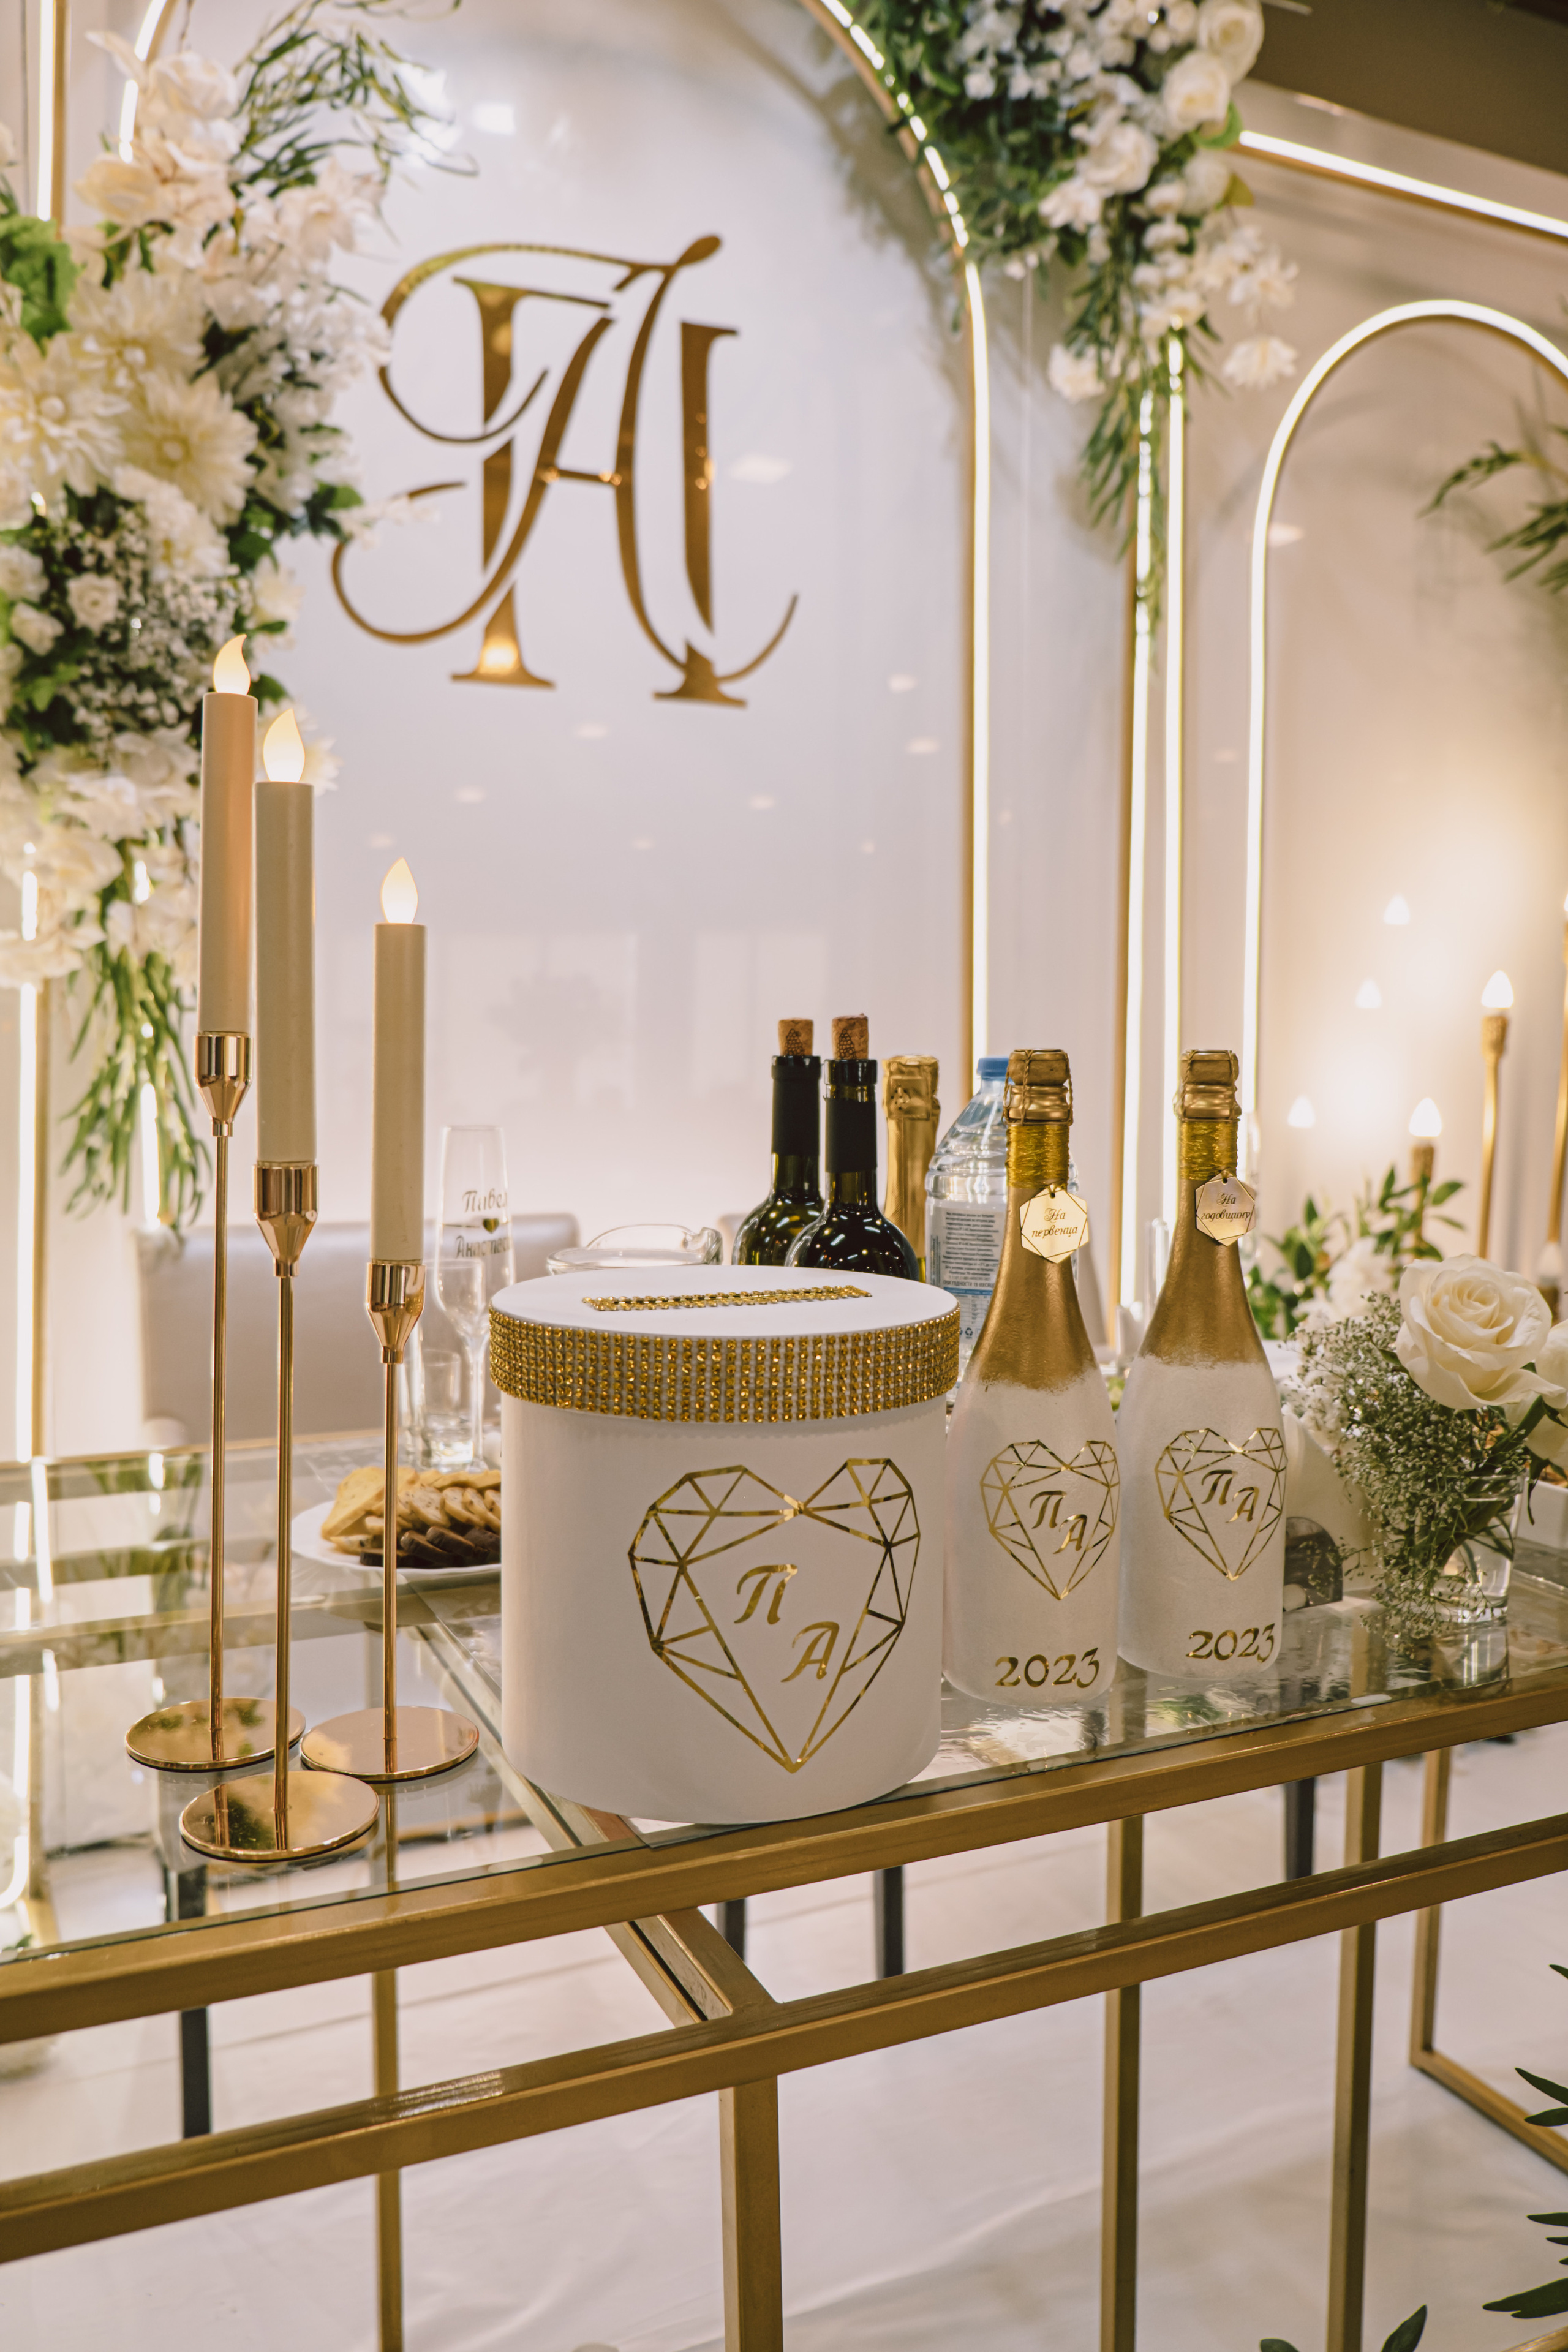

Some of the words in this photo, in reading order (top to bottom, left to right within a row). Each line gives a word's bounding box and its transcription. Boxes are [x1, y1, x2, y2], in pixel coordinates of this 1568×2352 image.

[1044, 1208, 1066, 1223] На
[1200, 1209, 1251, 1222] годовщину
[1216, 1192, 1236, 1207] На
[1031, 1225, 1078, 1238] первенца
[1200, 1469, 1238, 1505] П
[1030, 1490, 1067, 1529] П
[734, 1564, 798, 1624] П
[1186, 1623, 1275, 1663] 2023
[995, 1648, 1100, 1689] 2023
